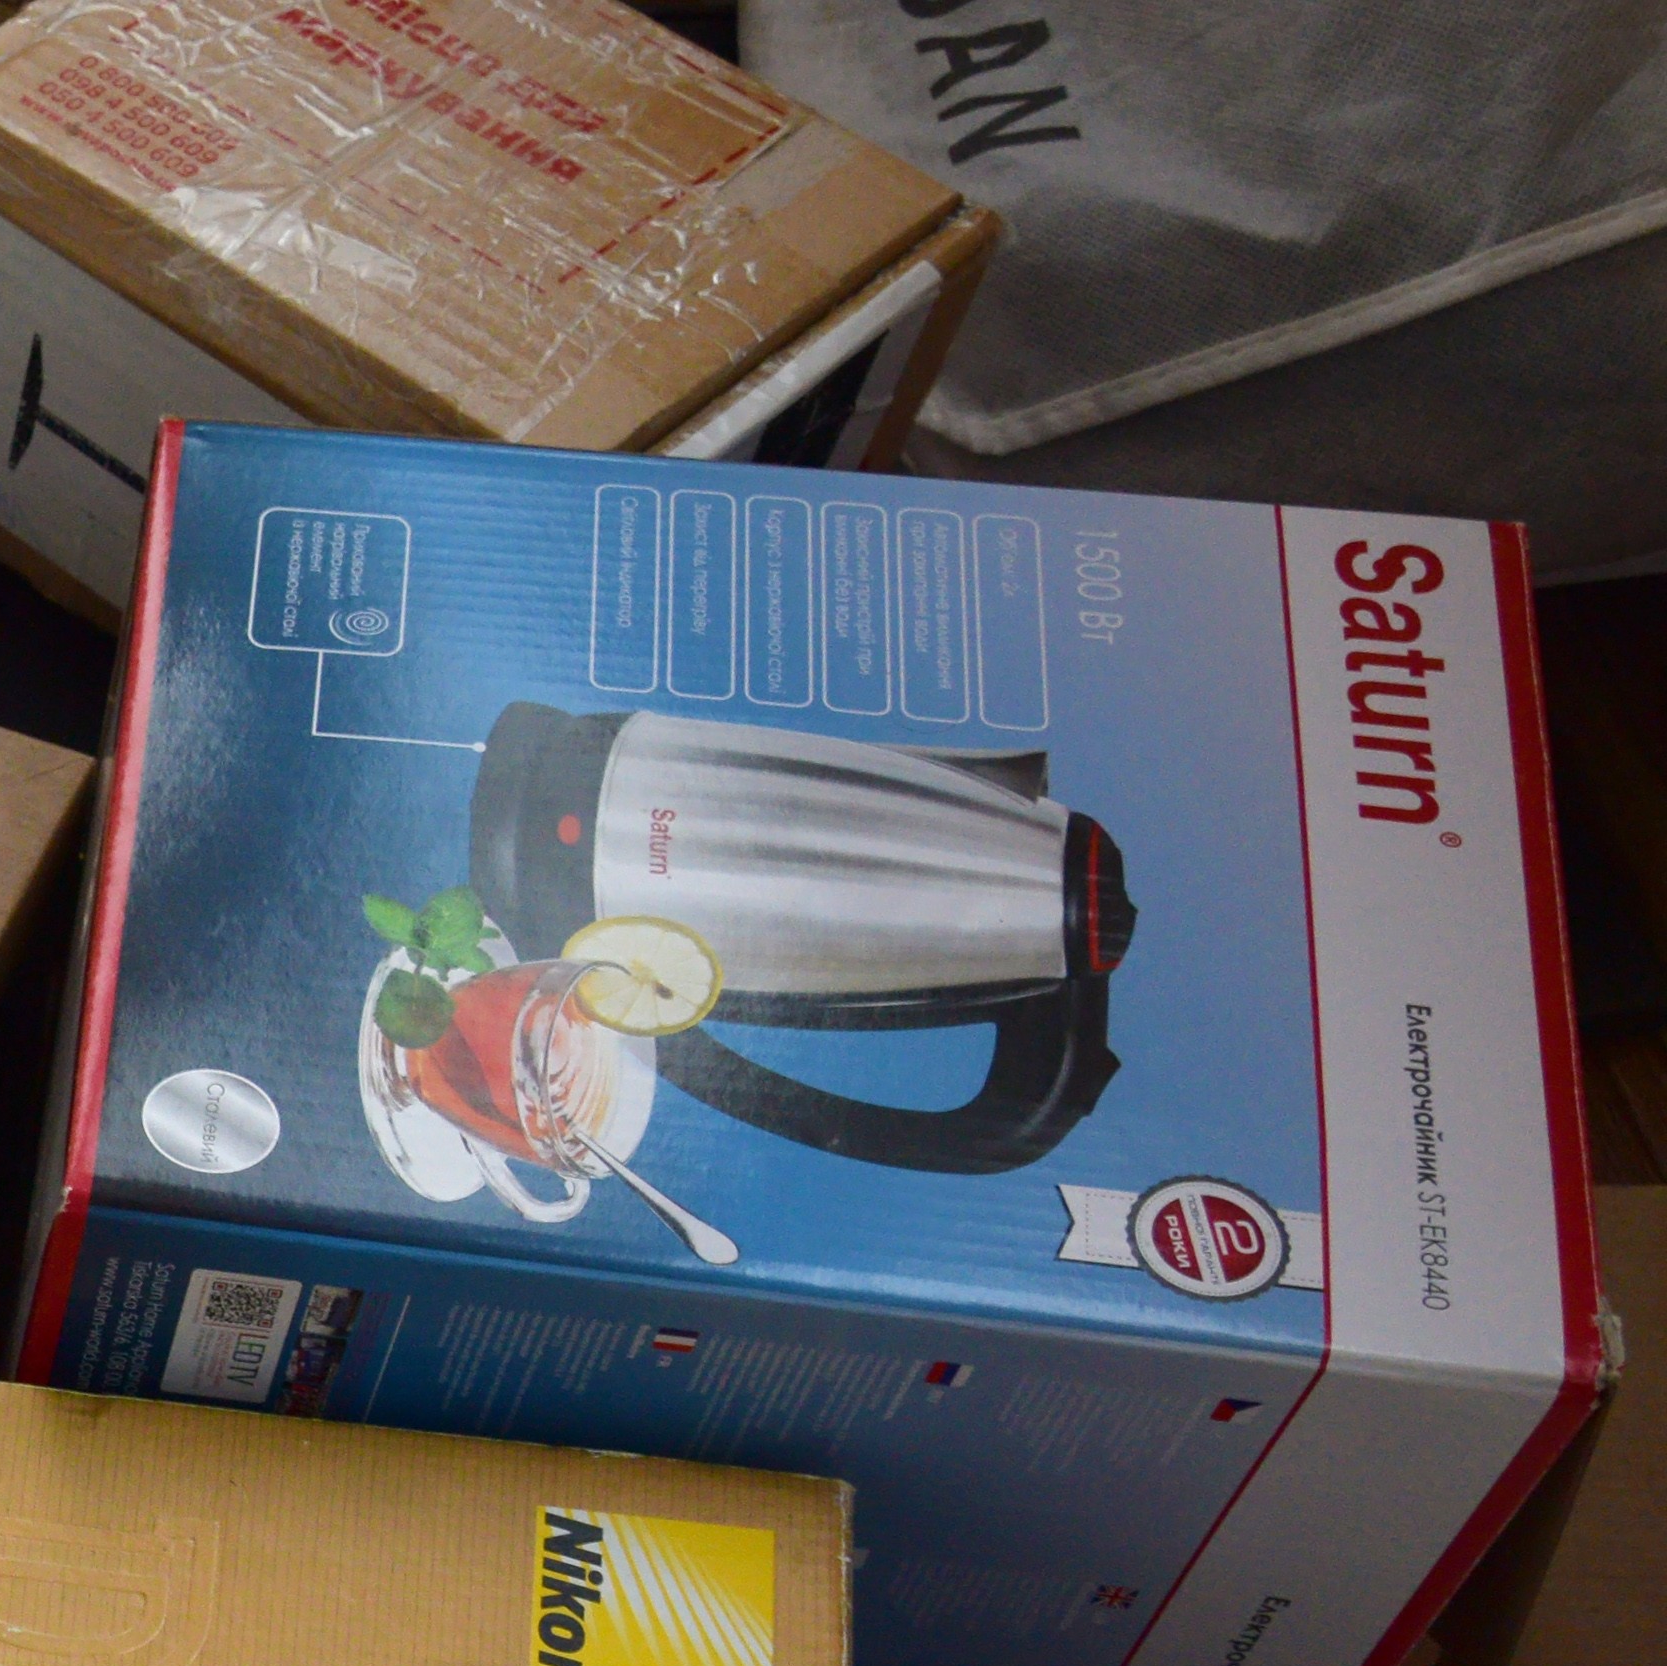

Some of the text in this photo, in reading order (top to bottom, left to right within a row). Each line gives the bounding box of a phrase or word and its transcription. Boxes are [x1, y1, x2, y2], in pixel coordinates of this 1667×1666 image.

[1074, 528, 1121, 602] 1500
[1333, 540, 1445, 827] Saturn
[649, 808, 676, 878] Saturn
[1405, 1003, 1451, 1312] Електрочайник ST-EK8440
[1165, 1215, 1191, 1268] РОКИ
